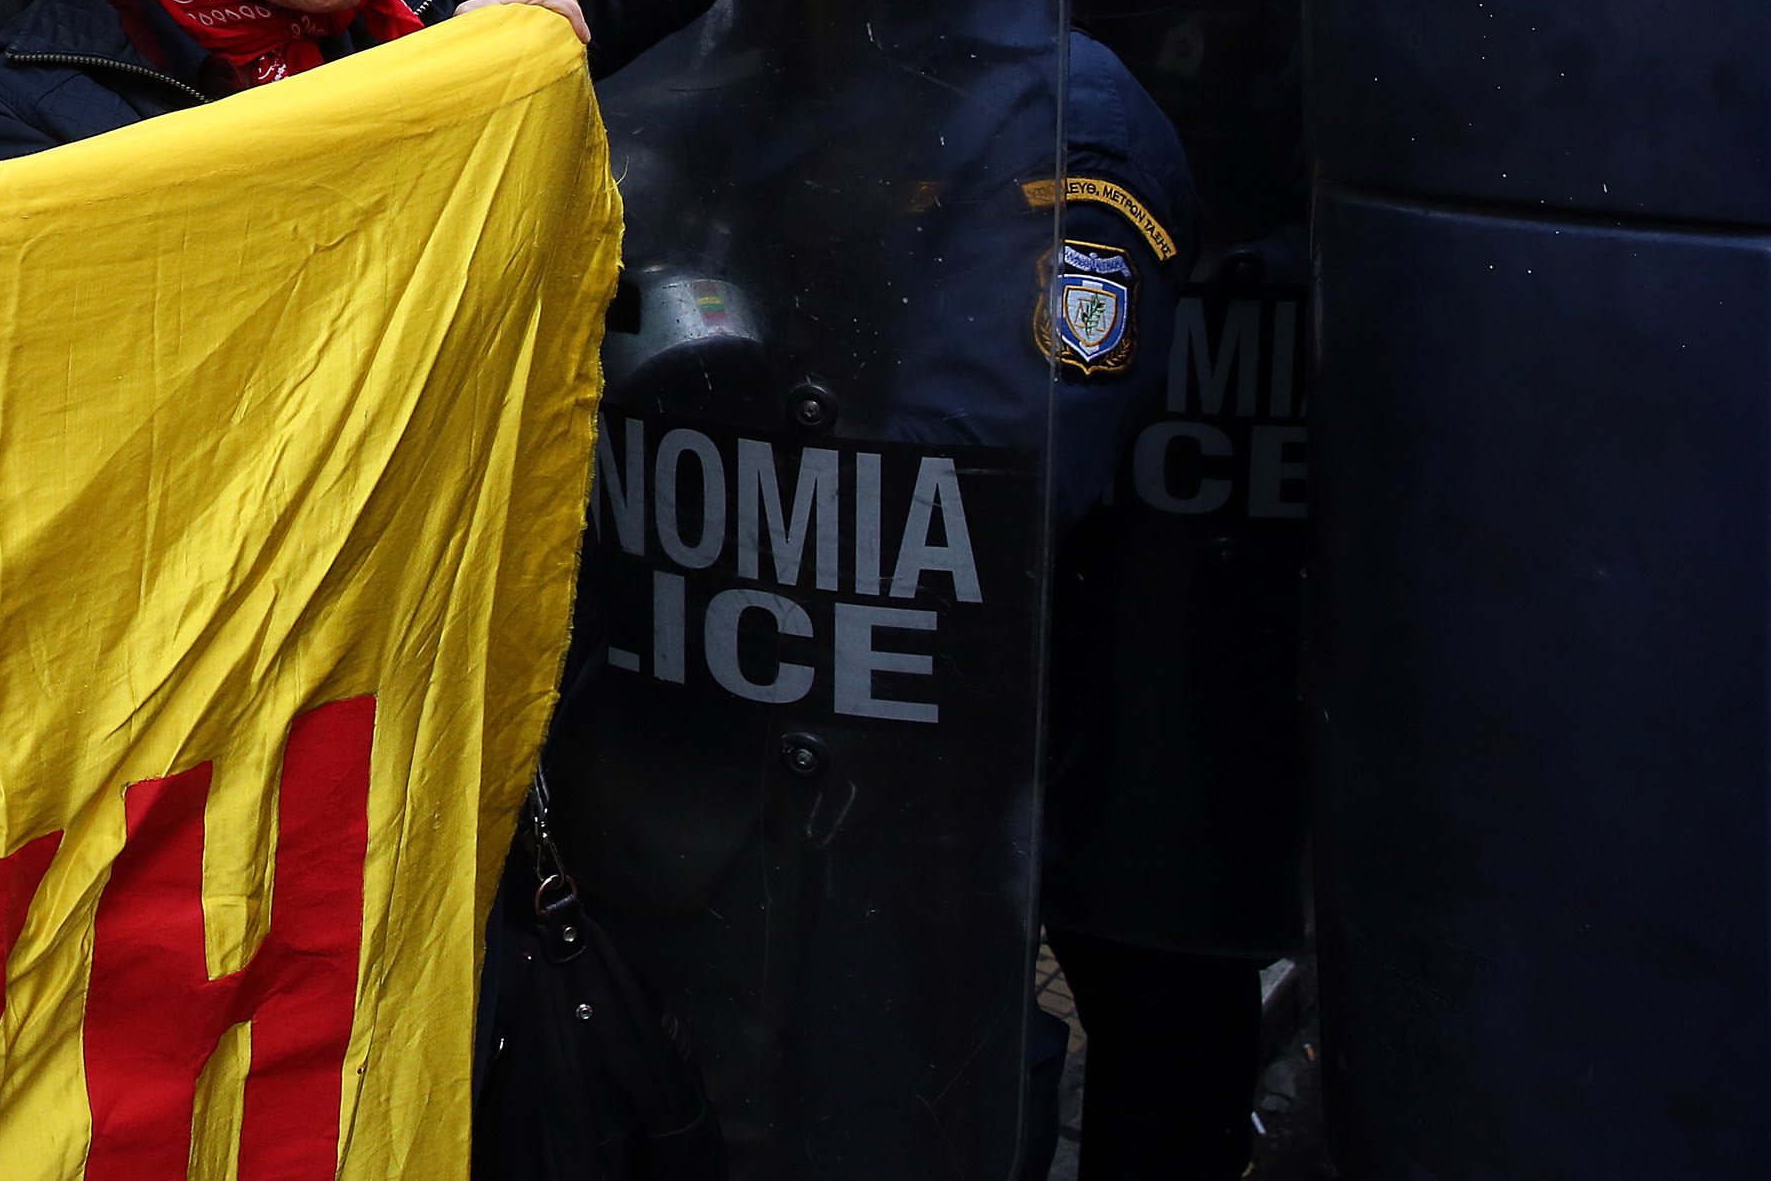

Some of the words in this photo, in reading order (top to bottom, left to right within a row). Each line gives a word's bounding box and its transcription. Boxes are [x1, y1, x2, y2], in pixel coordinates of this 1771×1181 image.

[1103, 185, 1146, 223] ΜΕΤΡΩΝ
[1143, 218, 1173, 256] ΤΑΞΗΣ
[1166, 296, 1307, 417] ΜΙ
